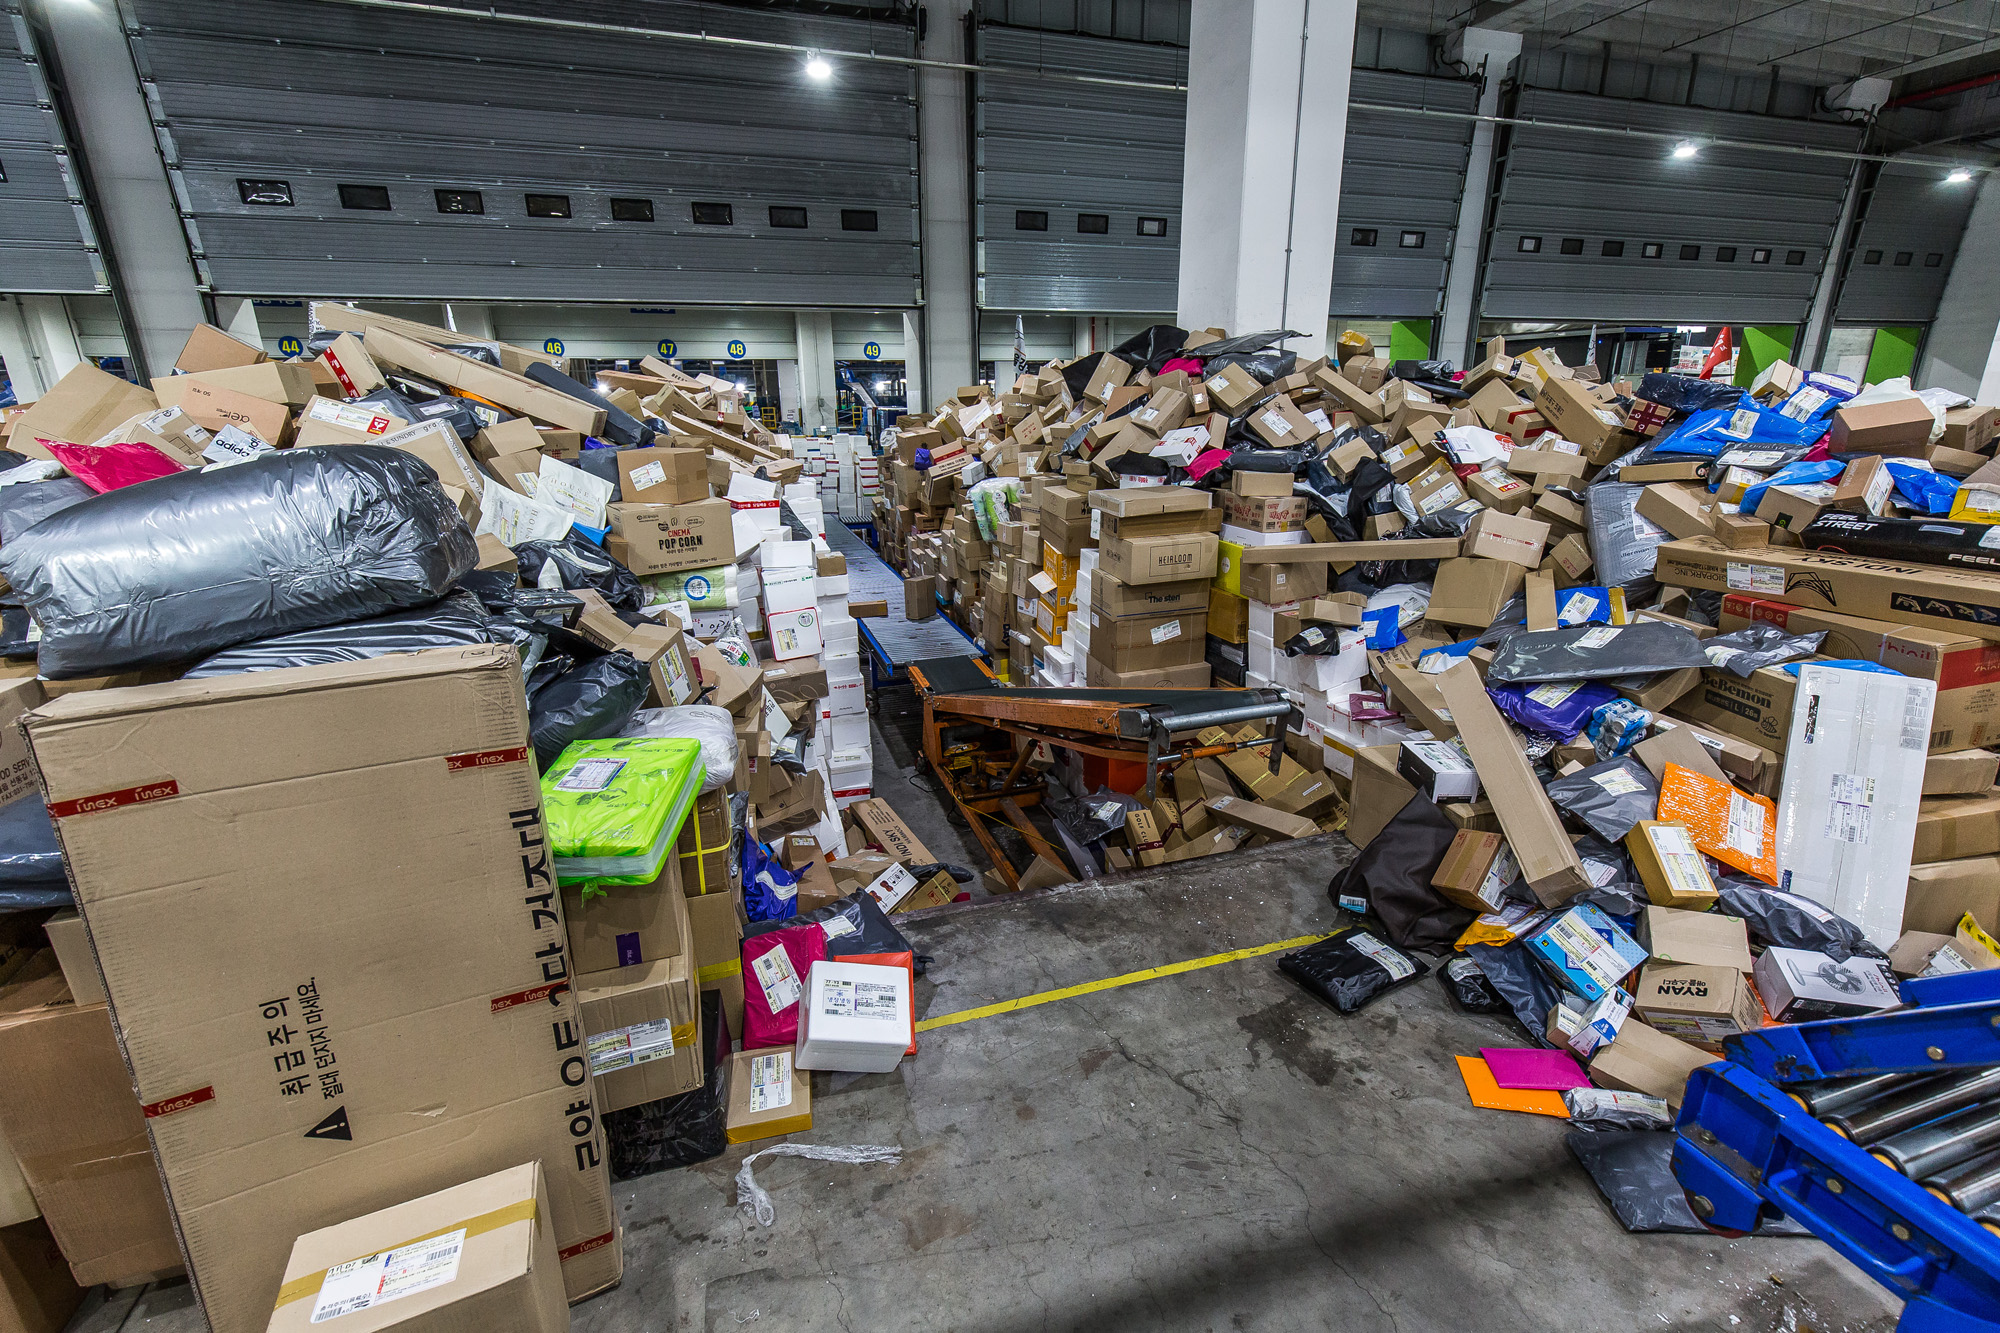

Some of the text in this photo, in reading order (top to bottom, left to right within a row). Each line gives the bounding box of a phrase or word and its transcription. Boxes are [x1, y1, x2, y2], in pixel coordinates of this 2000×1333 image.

[282, 340, 300, 353] 44
[546, 342, 562, 355] 46
[660, 343, 674, 355] 47
[730, 343, 744, 355] 48
[866, 345, 879, 357] 49
[391, 429, 417, 443] SUNDRY
[423, 422, 437, 433] gra
[215, 438, 250, 457] adida
[550, 478, 589, 498] HOUSE
[1818, 513, 1859, 521] FEEL
[525, 509, 539, 539] HOUS
[1811, 520, 1879, 531] STREET
[668, 528, 691, 537] CINEMA
[658, 534, 704, 550] POP CORN
[1158, 554, 1193, 566] HEIRLOOM
[1947, 553, 2000, 566] FEEL
[1674, 568, 1690, 577] INC
[1878, 641, 1931, 660] shinil
[1974, 664, 2000, 673] shini
[1702, 671, 1771, 709] BeBemon
[12, 756, 31, 774] SERV
[1134, 813, 1149, 843] GOLF CLU
[882, 829, 901, 843] SKY
[1657, 985, 1708, 997] RYAN
[296, 976, 345, 1100] 절대 던지지 마세요.
[258, 996, 312, 1097] 취급주의
